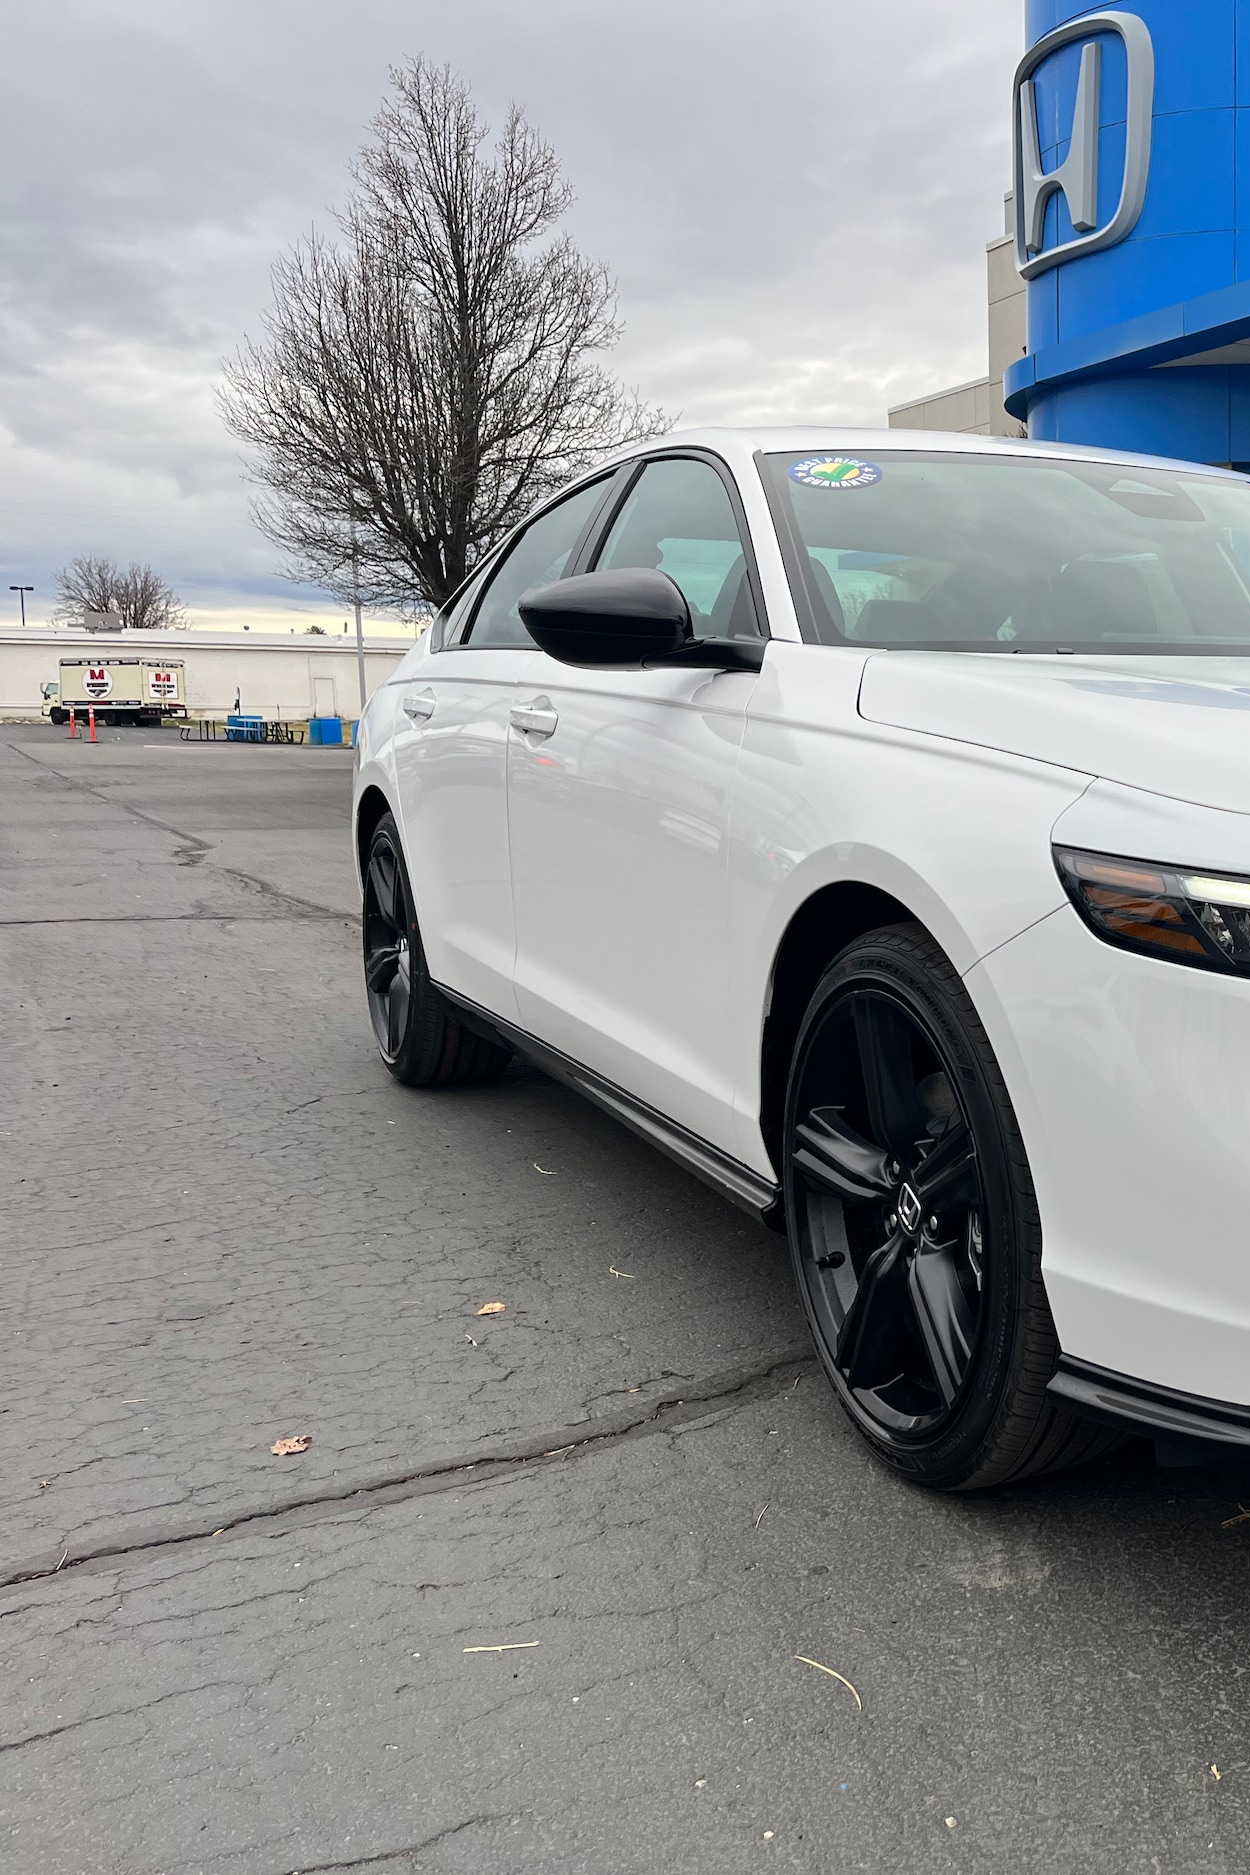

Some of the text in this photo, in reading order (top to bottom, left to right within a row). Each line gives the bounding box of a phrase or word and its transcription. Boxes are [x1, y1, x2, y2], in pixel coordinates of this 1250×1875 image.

[794, 457, 867, 471] BEST PRICE
[89, 669, 105, 680] M
